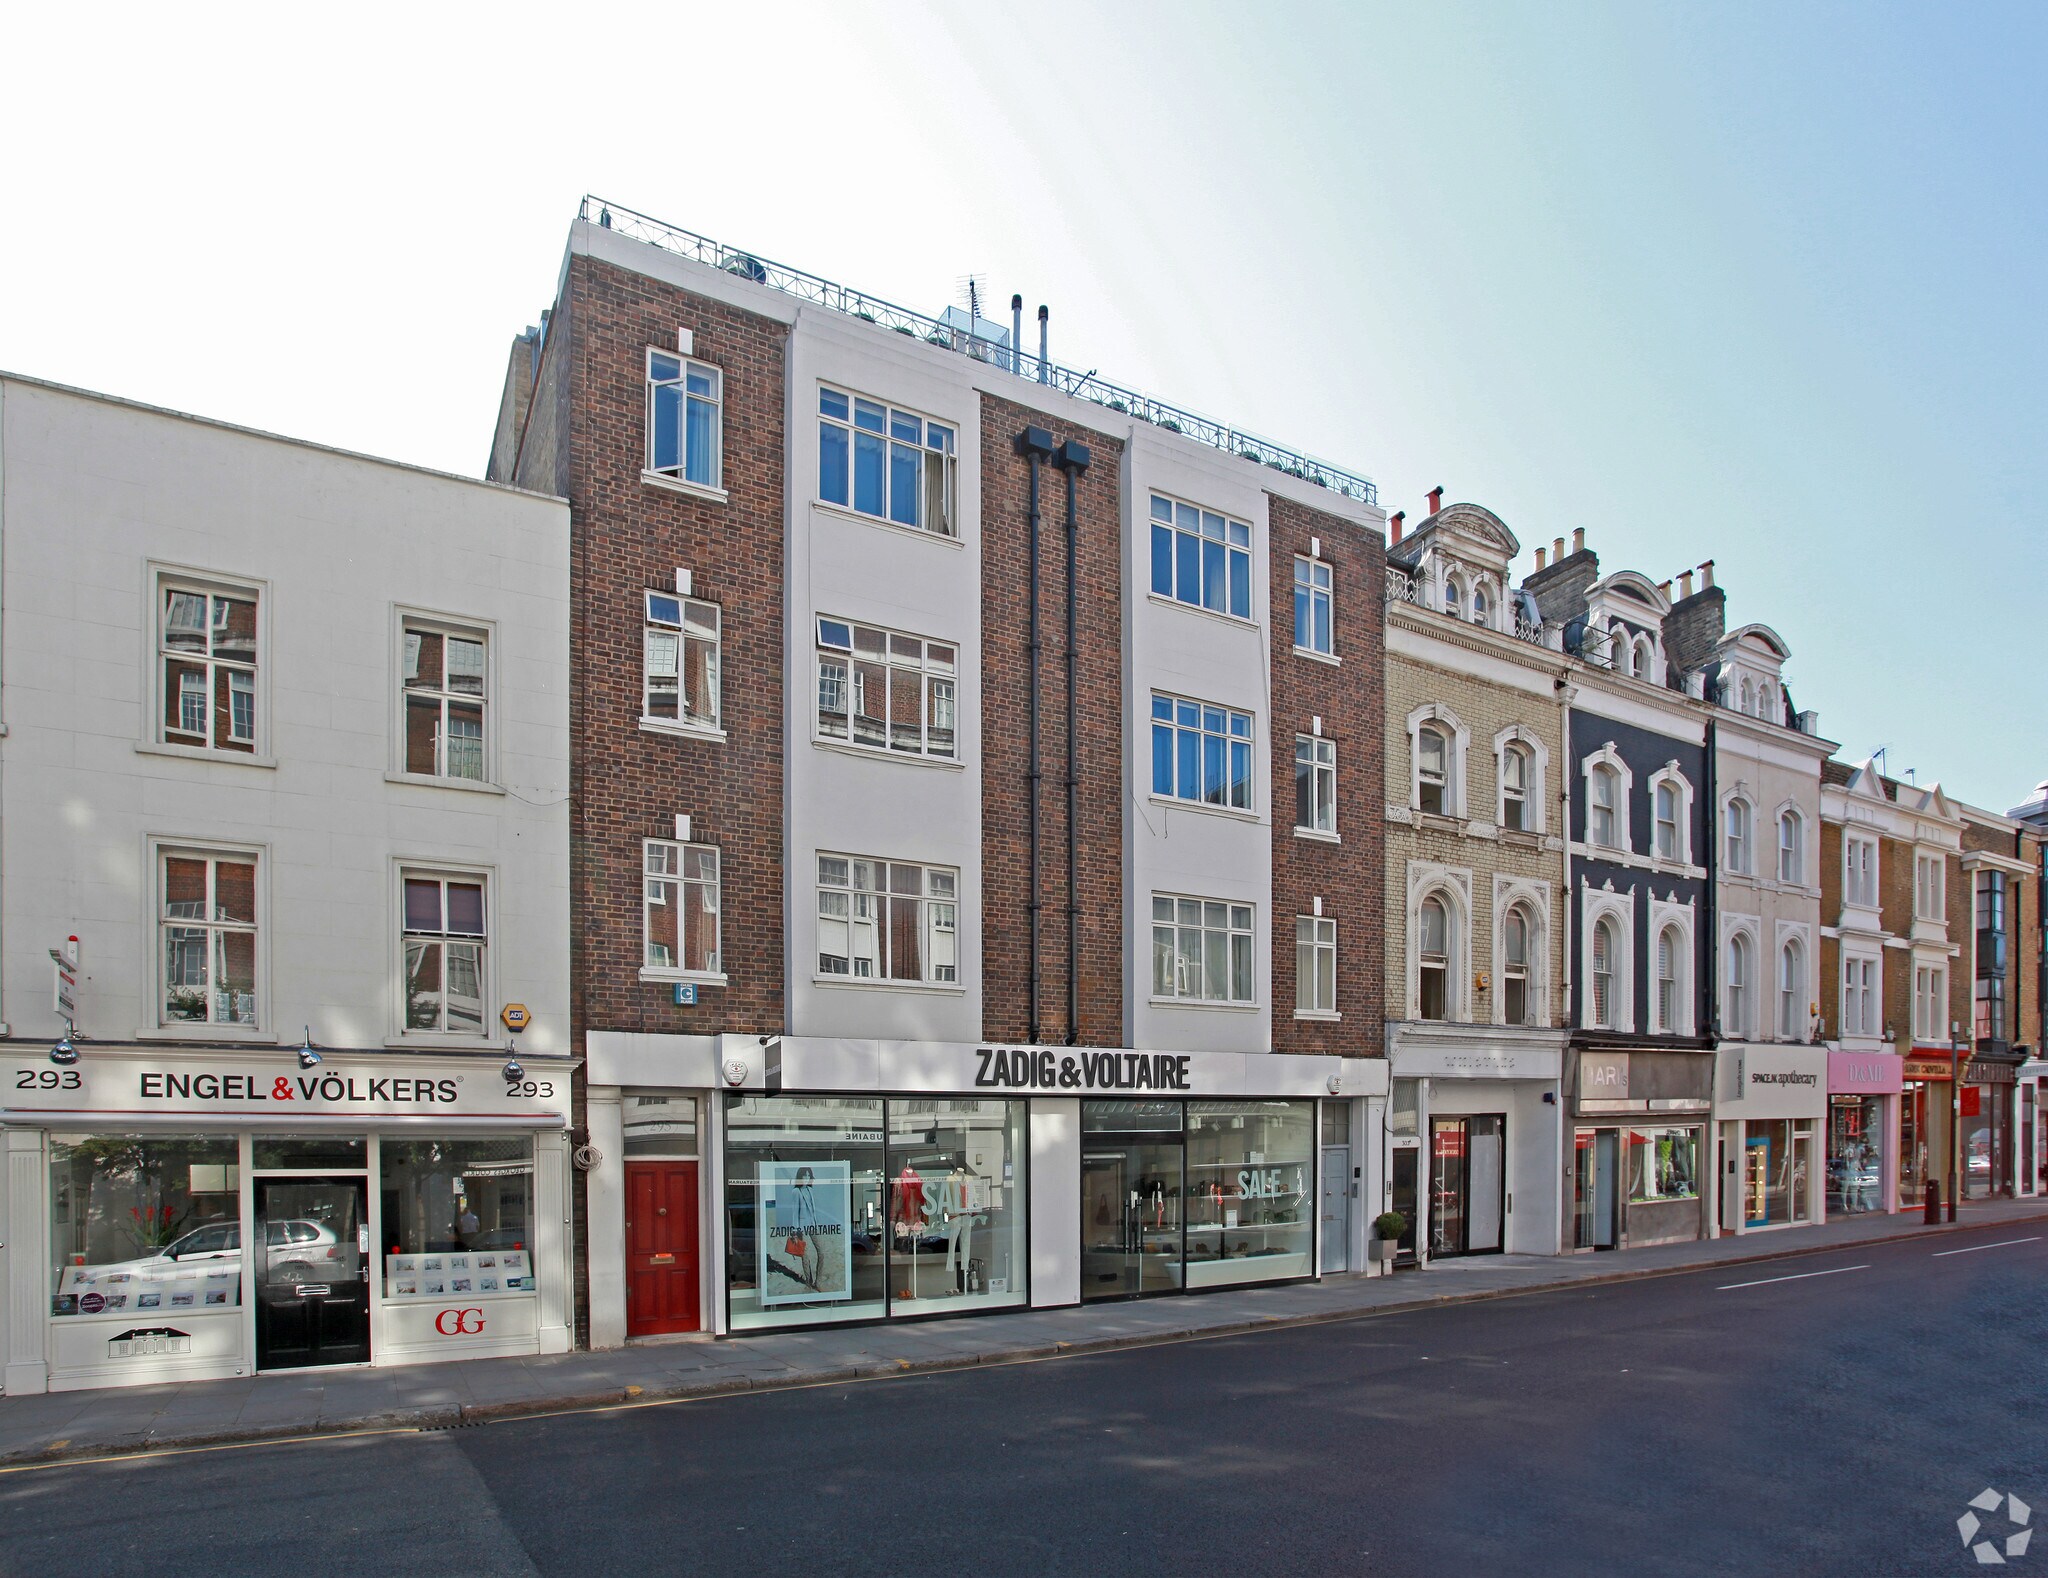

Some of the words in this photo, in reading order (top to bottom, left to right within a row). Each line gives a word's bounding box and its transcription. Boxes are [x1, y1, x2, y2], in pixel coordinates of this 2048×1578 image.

[16, 1070, 82, 1090] 293
[1778, 1070, 1818, 1088] apothecary
[506, 1081, 554, 1098] 293
[1237, 1168, 1282, 1200] SALE
[435, 1307, 487, 1336] GG
